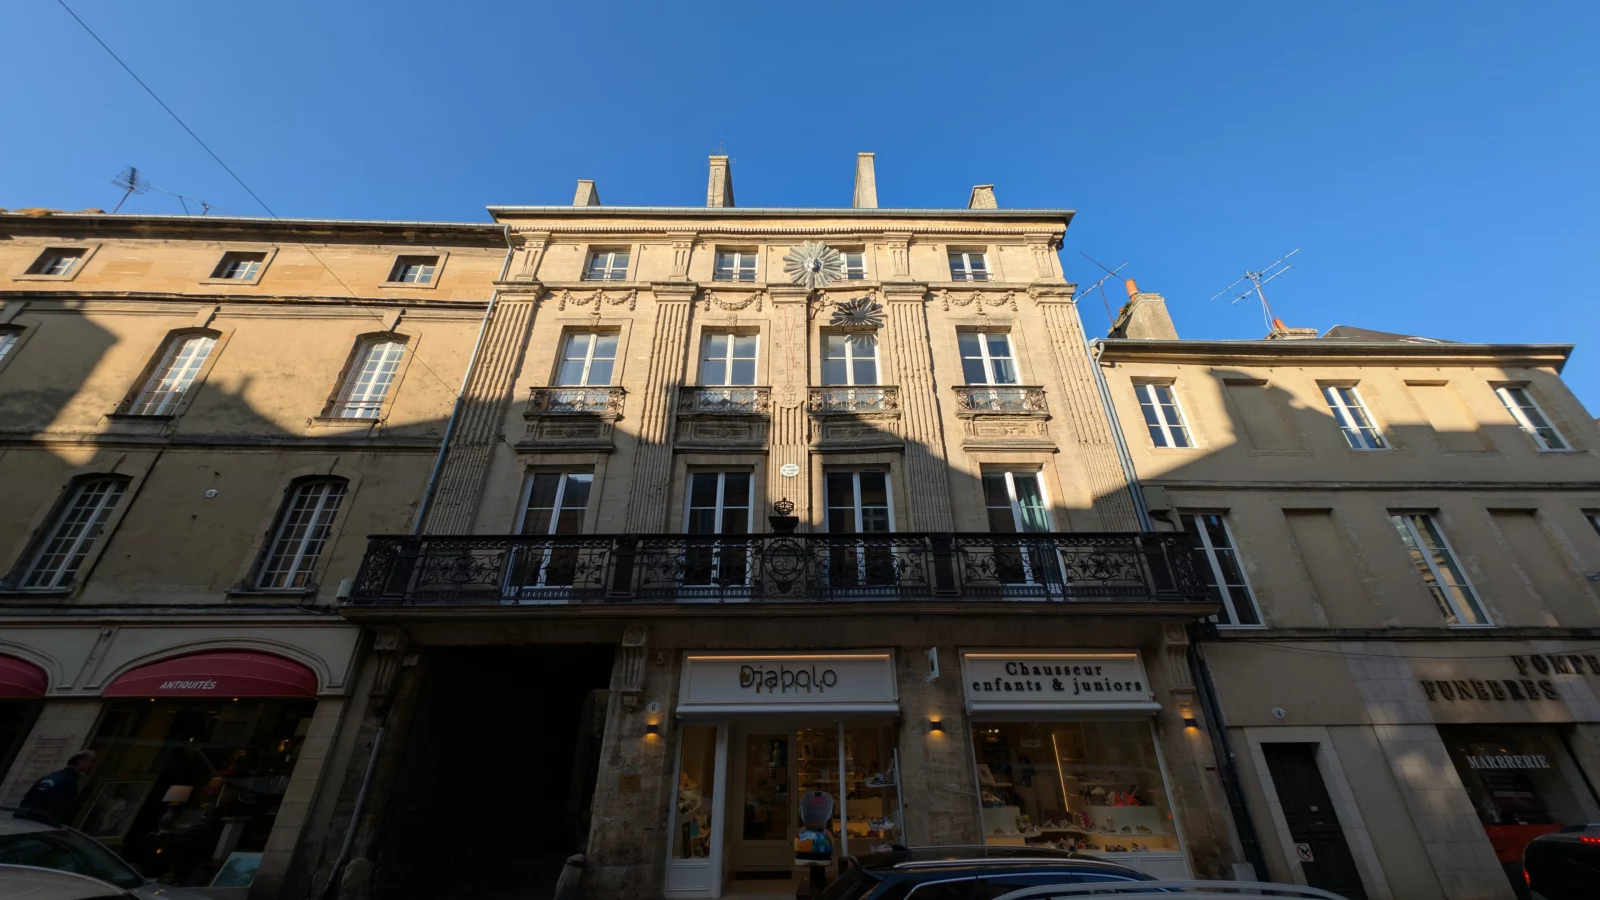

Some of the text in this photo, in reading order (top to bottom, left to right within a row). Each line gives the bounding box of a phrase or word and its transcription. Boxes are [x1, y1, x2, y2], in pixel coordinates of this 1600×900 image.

[739, 664, 838, 688] Diabolo
[1005, 661, 1103, 676] Chausseur
[158, 678, 218, 691] ANTIQUITÉS
[972, 677, 1143, 695] enfants & juniors
[1465, 754, 1552, 769] MARBRERIE
